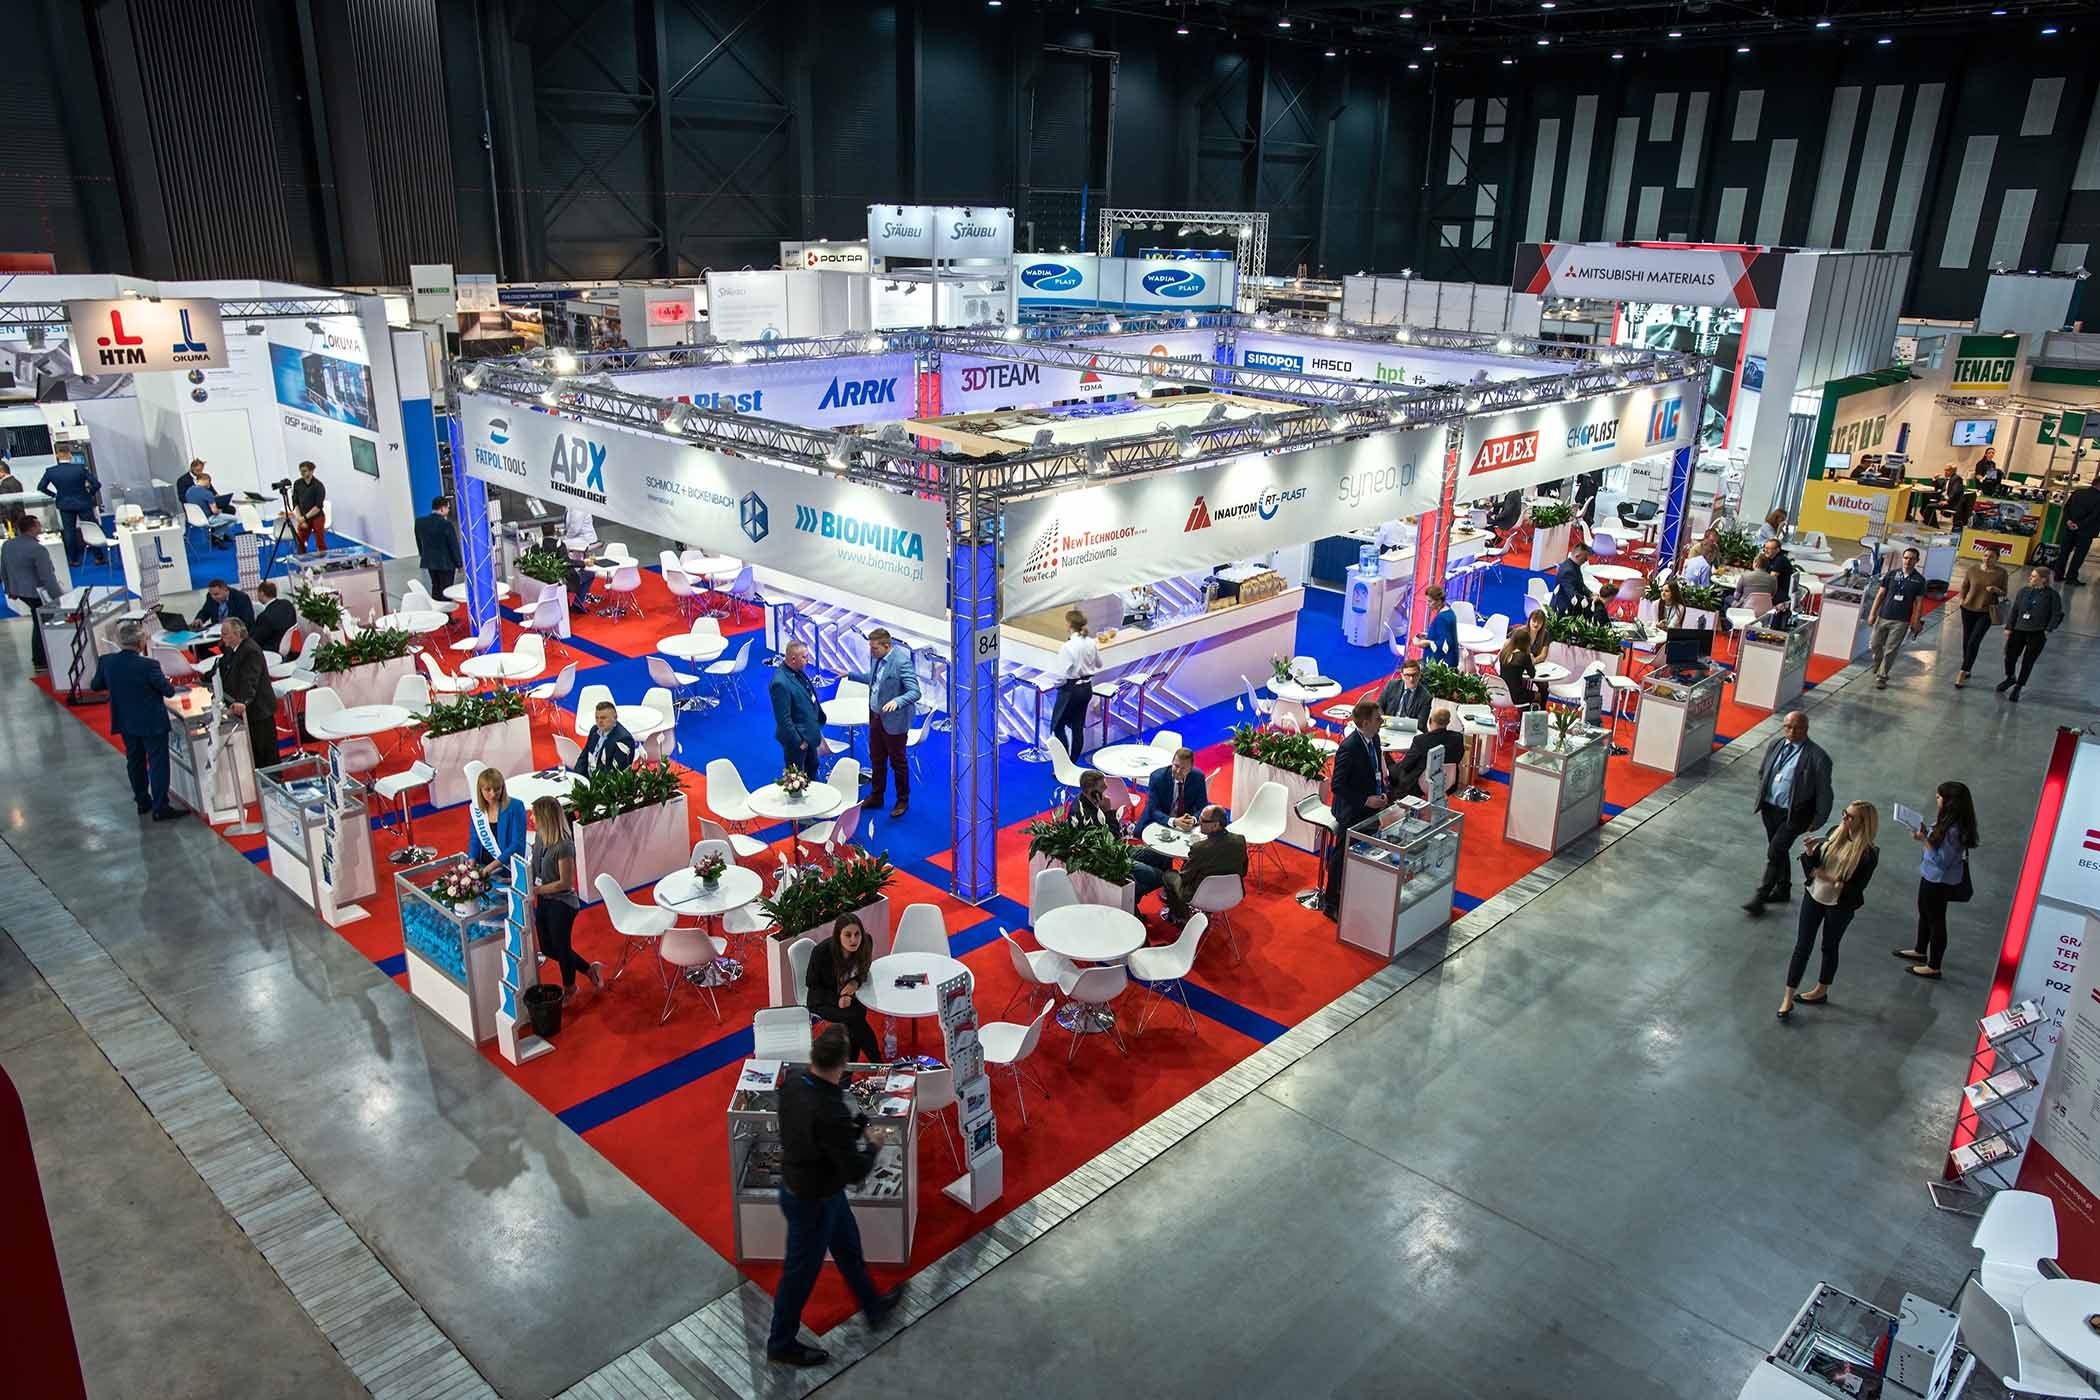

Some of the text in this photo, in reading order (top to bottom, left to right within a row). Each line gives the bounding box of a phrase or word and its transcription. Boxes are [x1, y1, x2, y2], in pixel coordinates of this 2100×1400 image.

[882, 222, 922, 239] STÄUBLI
[950, 222, 997, 240] STÄUBLI
[1026, 269, 1052, 277] WADIM
[1578, 268, 1715, 286] MITSUBISHI MATERIALS
[328, 334, 361, 352] OKUMA
[99, 348, 147, 365] HTM
[172, 354, 211, 362] OKUMA
[1247, 352, 1301, 369] SIROPOL
[1312, 358, 1352, 373] HASCO
[961, 364, 1041, 392] 3DTEAM
[1376, 362, 1406, 384] hpt
[1953, 359, 2015, 383] TENACO
[818, 376, 898, 410] ARRK
[1079, 384, 1103, 392] TOMA
[388, 443, 399, 451] 79
[1476, 436, 1538, 469] APLEX
[475, 448, 527, 477] FATPOL TOOLS
[550, 433, 607, 493] APX
[1339, 453, 1417, 508] syneo.pl
[550, 480, 607, 505] TECHNOLOGIE
[646, 475, 680, 495] SCHMOLZ
[688, 486, 735, 509] BICKENBACH
[1265, 486, 1308, 506] RT-PLAST
[1214, 502, 1258, 521] INAUTOM
[821, 511, 924, 562] BIOMIKA
[979, 633, 998, 655] 84
